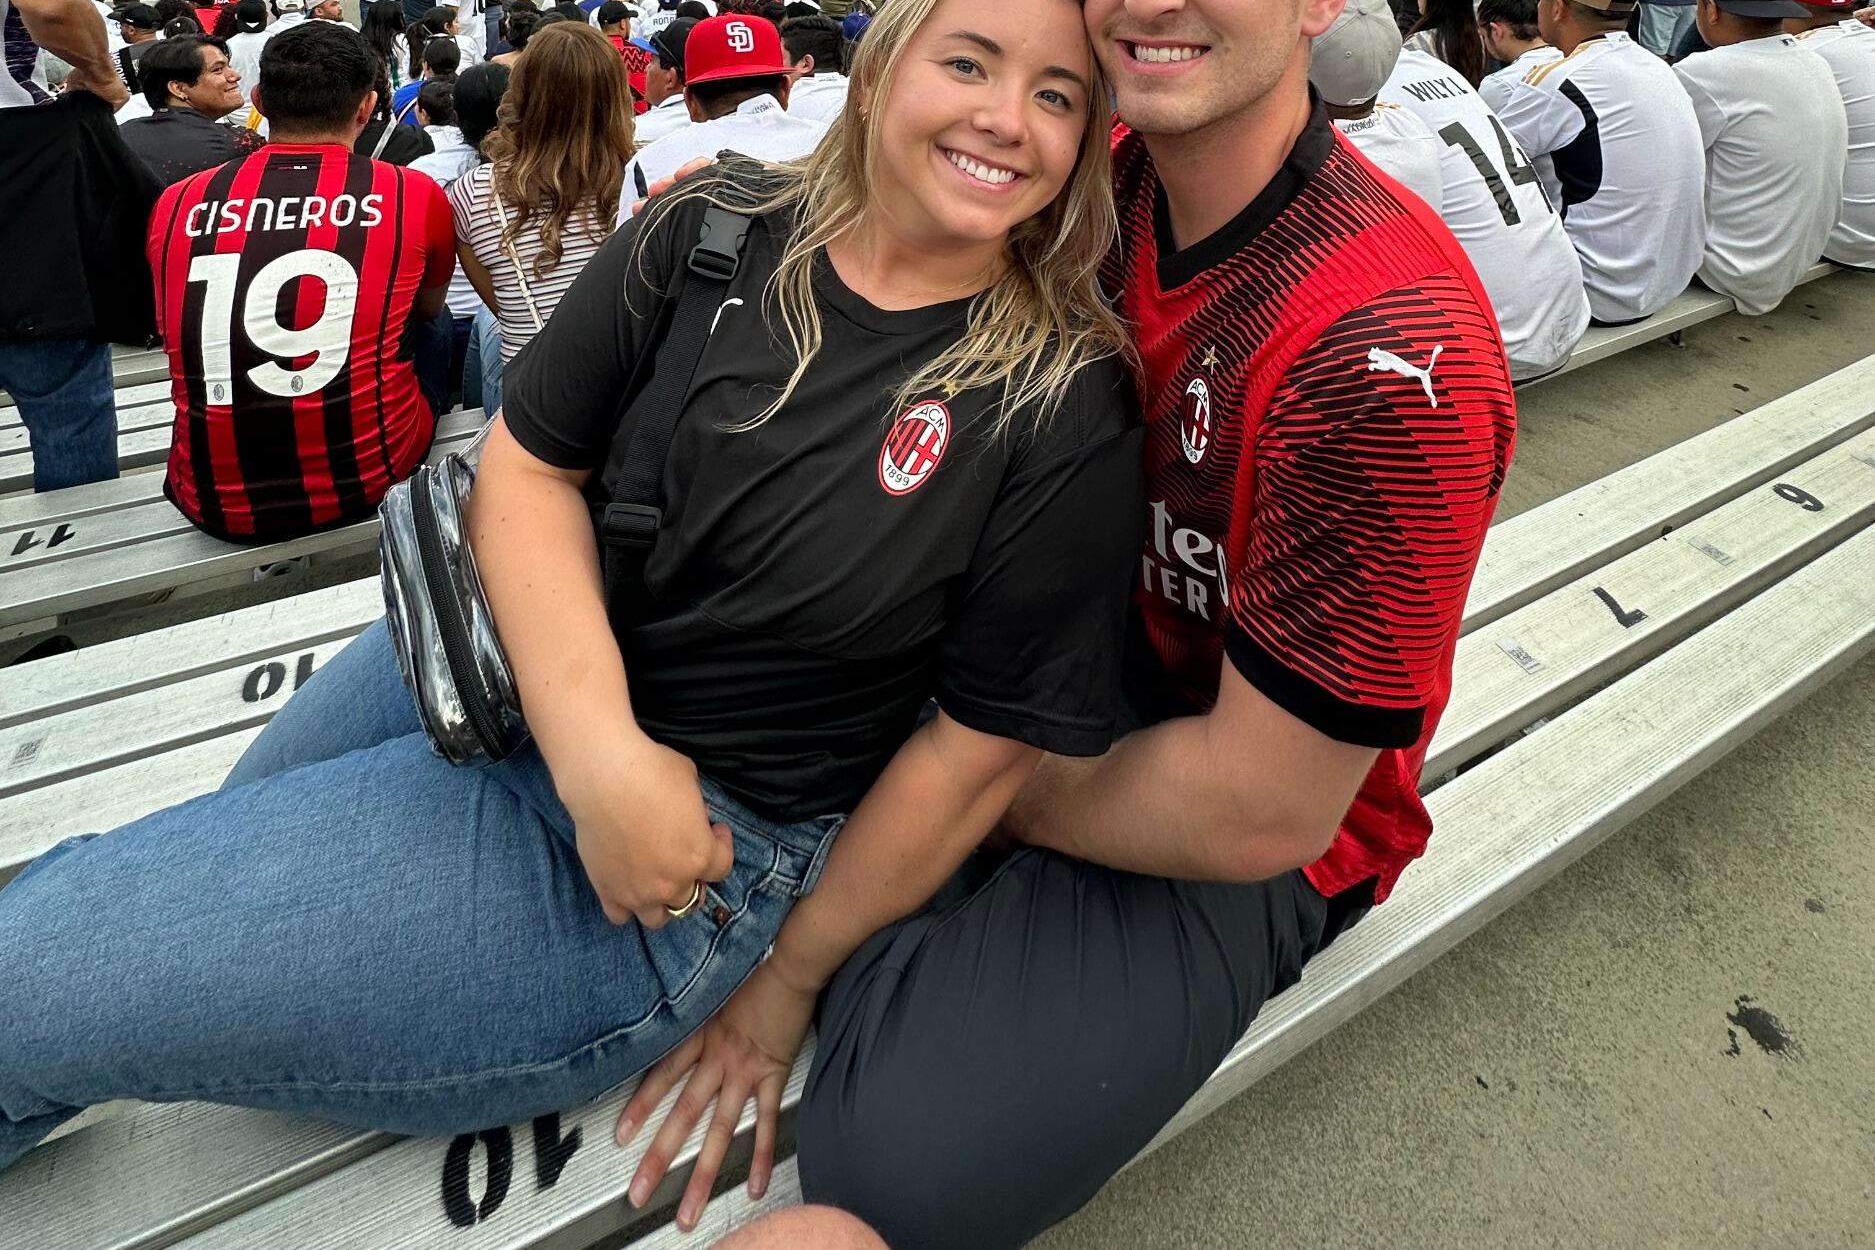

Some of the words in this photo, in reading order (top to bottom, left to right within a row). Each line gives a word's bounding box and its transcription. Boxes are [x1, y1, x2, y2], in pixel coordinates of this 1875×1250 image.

[725, 21, 754, 52] SD
[1438, 115, 1554, 226] 14
[185, 194, 383, 237] CISNEROS
[187, 249, 358, 405] 19
[1190, 380, 1209, 407] ACM
[916, 405, 945, 432] ACM
[885, 463, 911, 486] 1899
[11, 523, 76, 556] 11
[441, 1110, 583, 1228] 10
